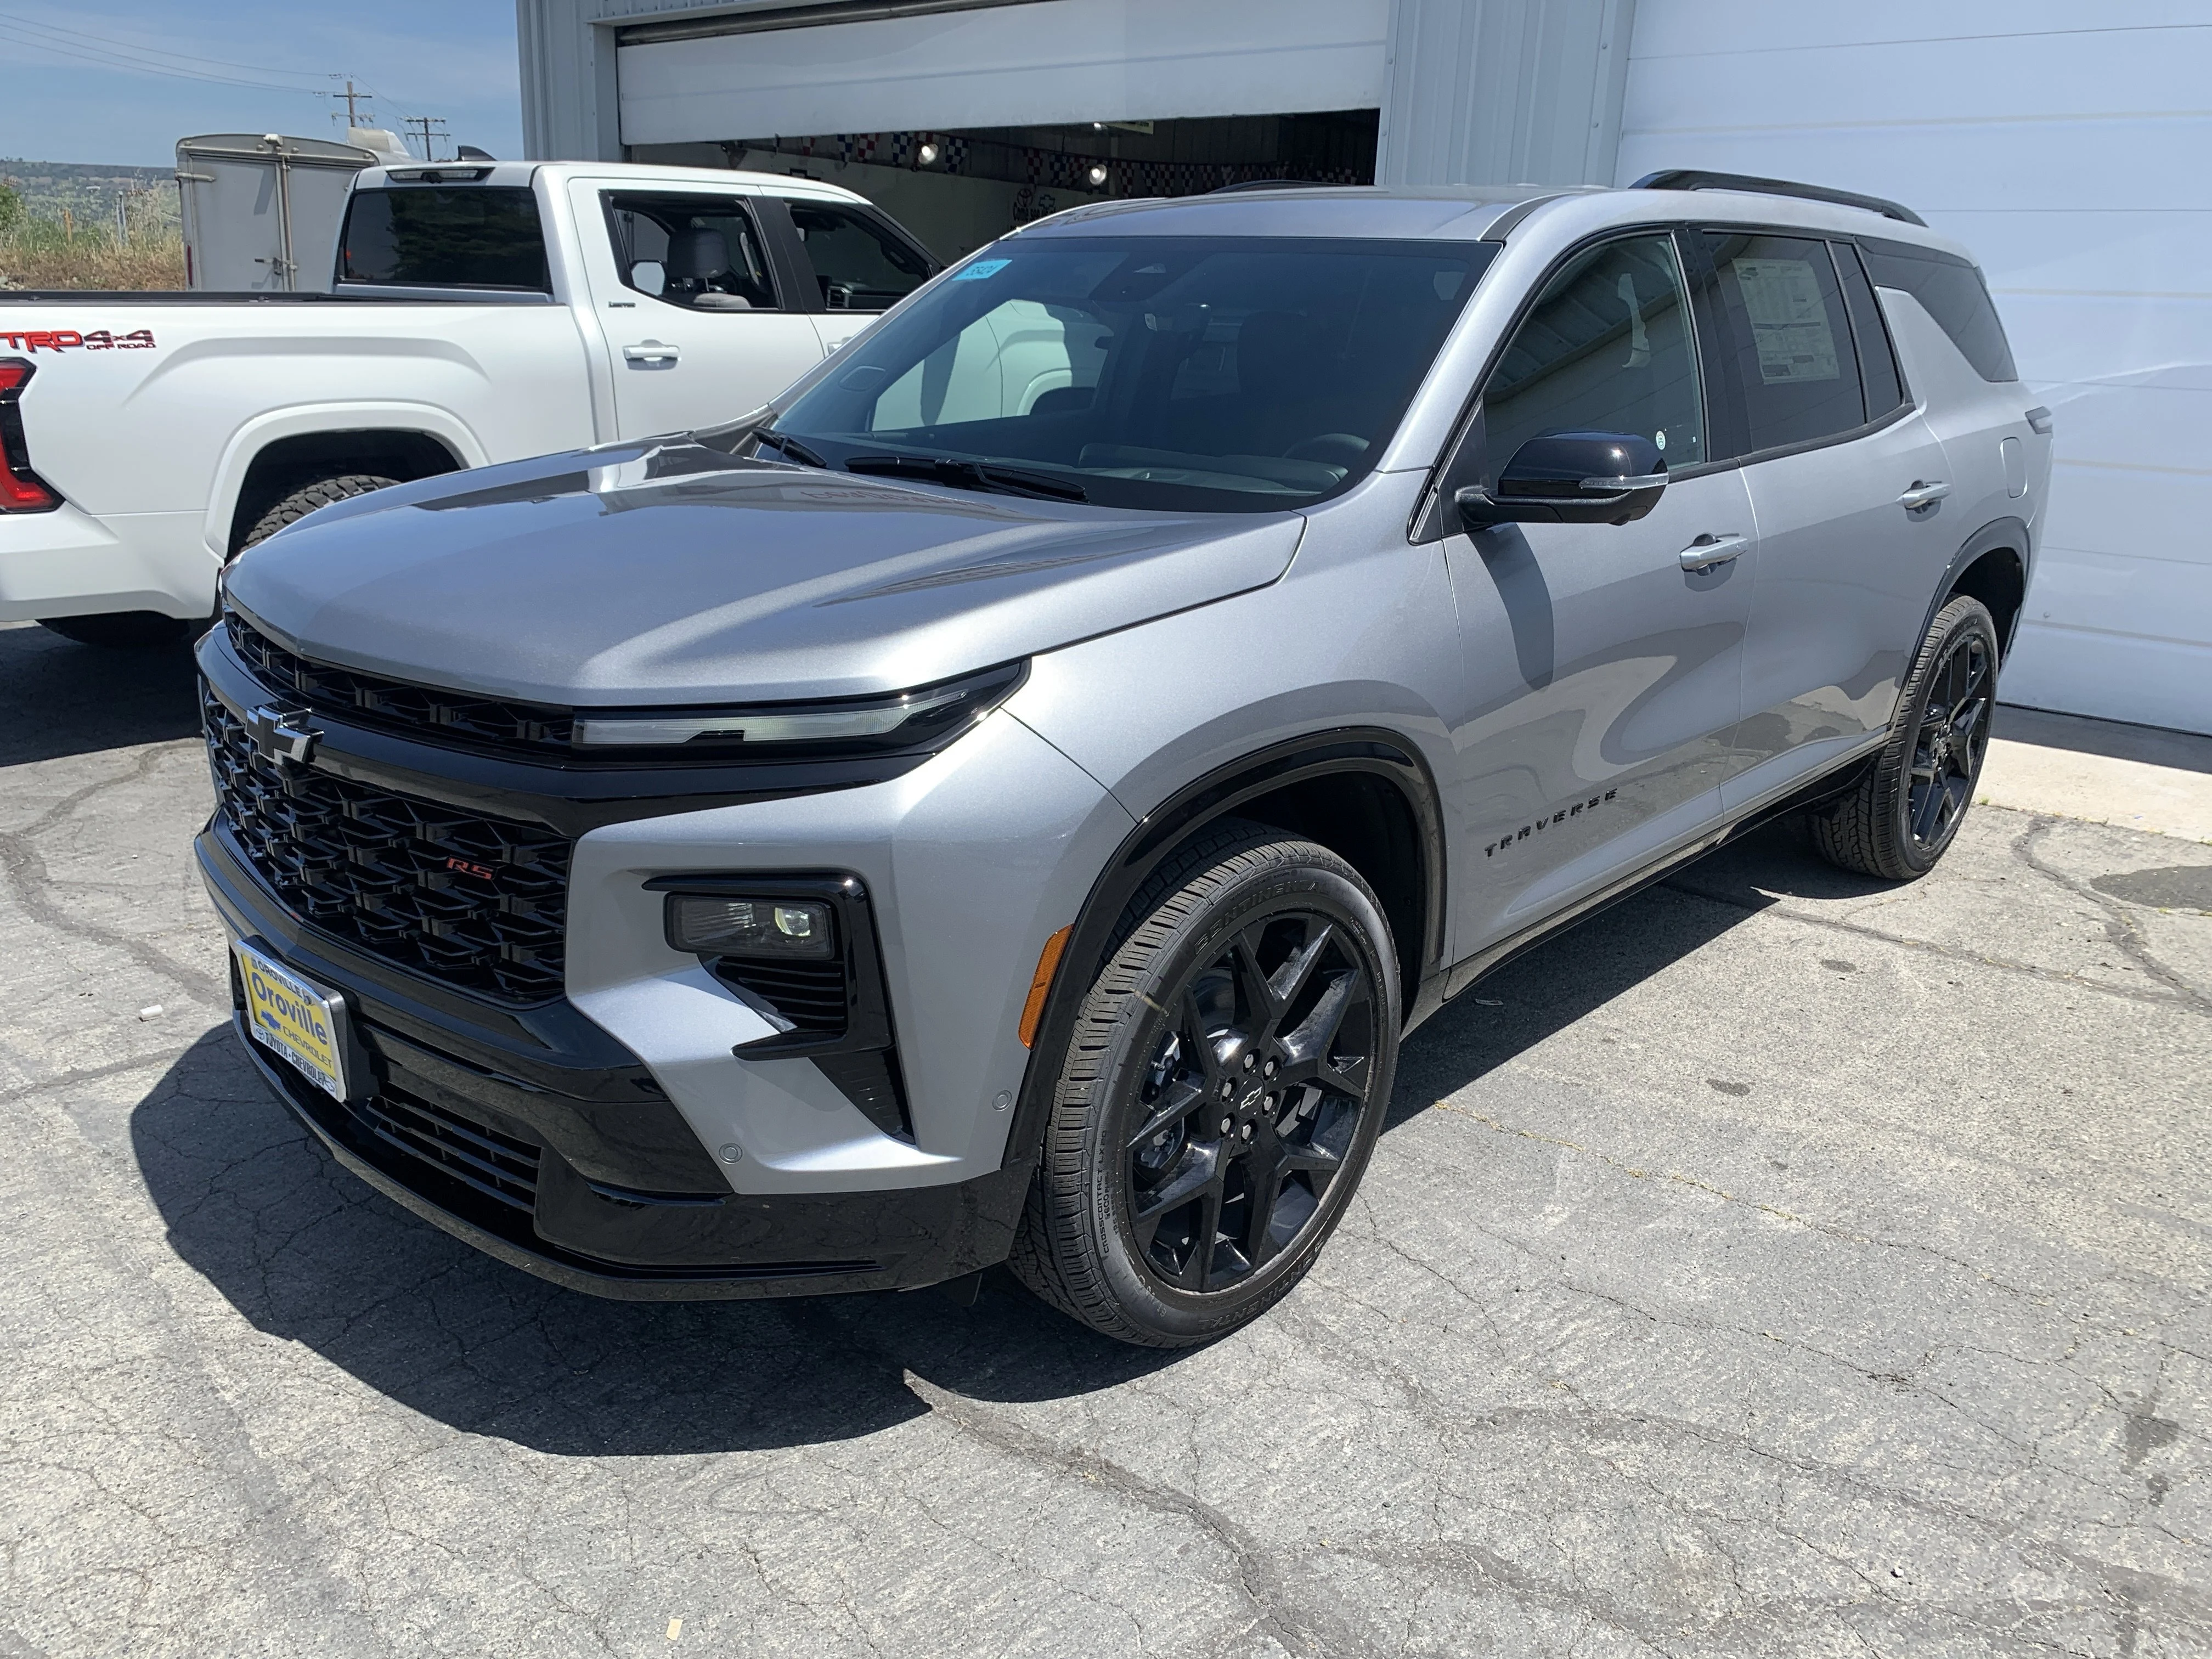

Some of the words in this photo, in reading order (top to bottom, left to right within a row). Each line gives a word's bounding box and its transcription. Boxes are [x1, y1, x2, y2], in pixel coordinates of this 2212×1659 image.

[0, 330, 83, 354] TRD
[1484, 788, 1618, 857] TRAVERSE
[447, 856, 493, 880] RS
[258, 962, 303, 1000] OROVILLE
[251, 972, 328, 1046] Oroville
[265, 1032, 288, 1059] TOYOTA
[291, 1053, 328, 1086] CHEVROLET
[283, 1025, 334, 1069] CHEVROLET
